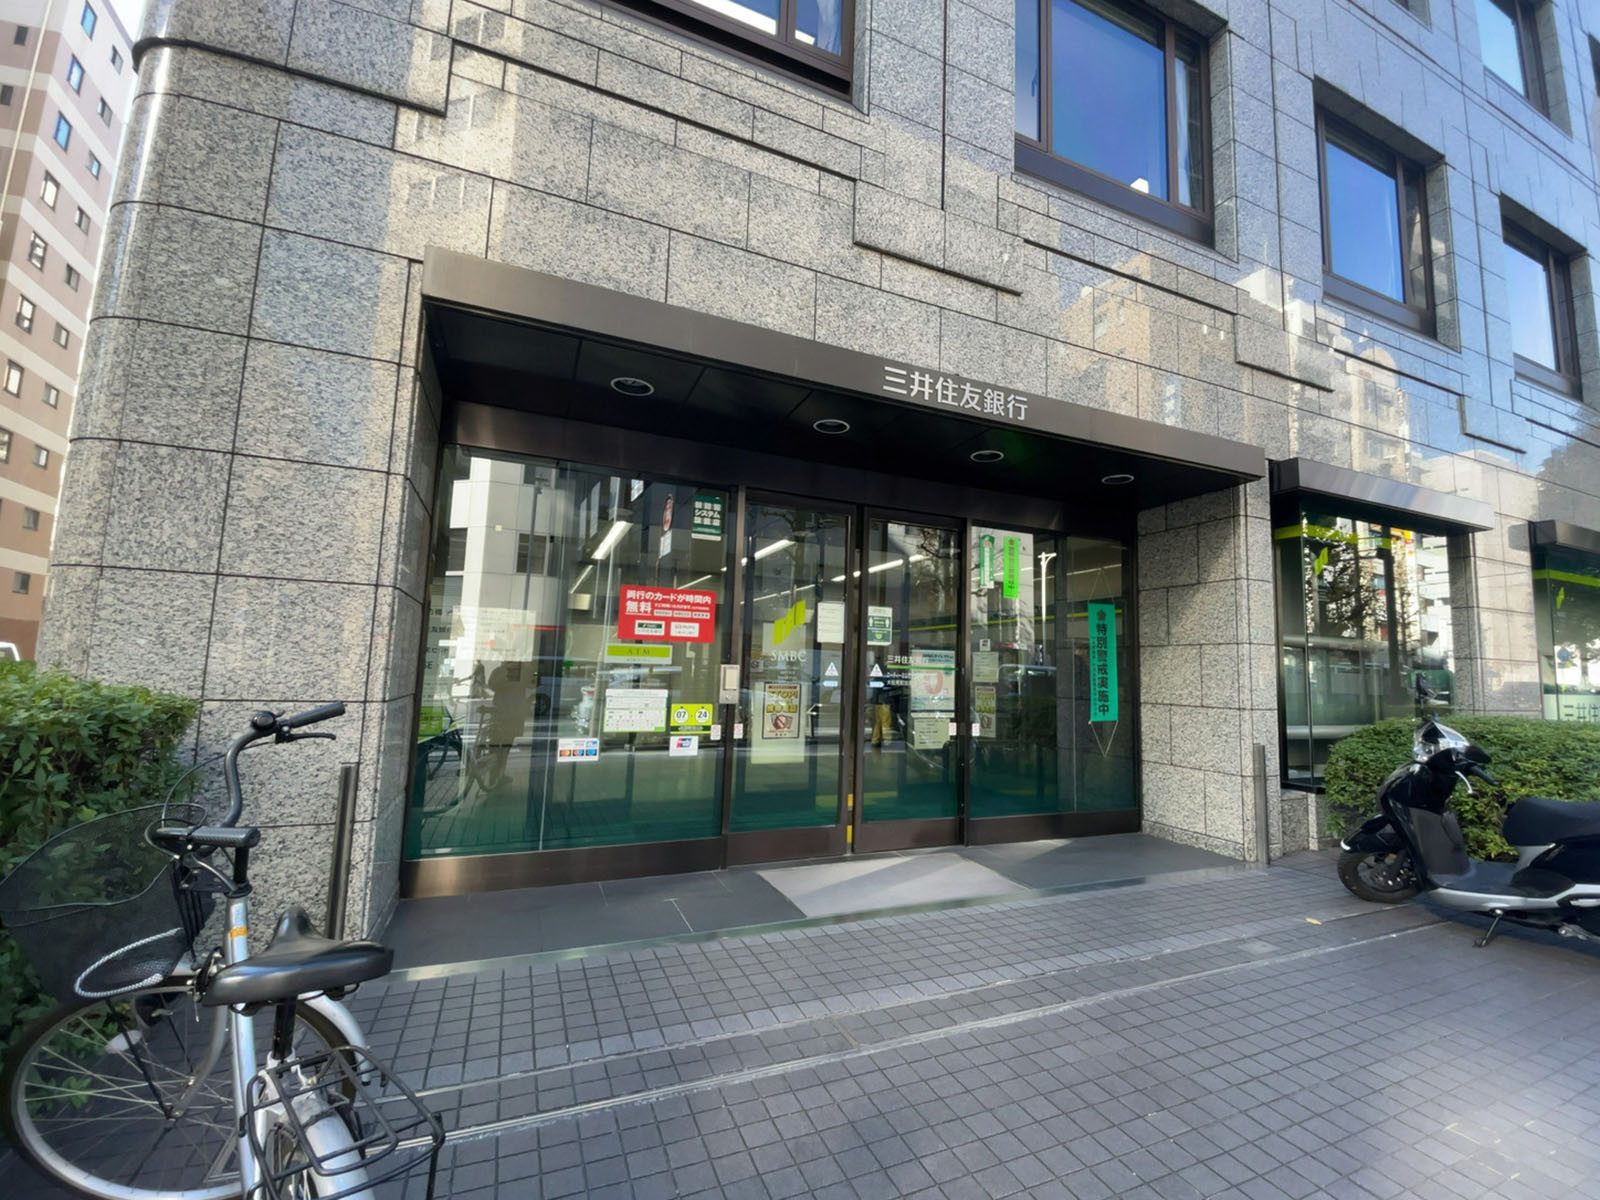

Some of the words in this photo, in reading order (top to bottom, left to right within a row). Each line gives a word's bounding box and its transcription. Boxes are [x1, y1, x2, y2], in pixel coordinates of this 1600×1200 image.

[883, 366, 1028, 420] 三井住友銀行
[694, 509, 720, 518] システム
[626, 589, 712, 604] 両行のカードが時間内
[625, 600, 652, 613] 無料
[770, 650, 807, 662] SMBC
[1096, 623, 1109, 716] 特別警戒実施中
[676, 711, 687, 719] 07
[697, 711, 708, 719] 24
